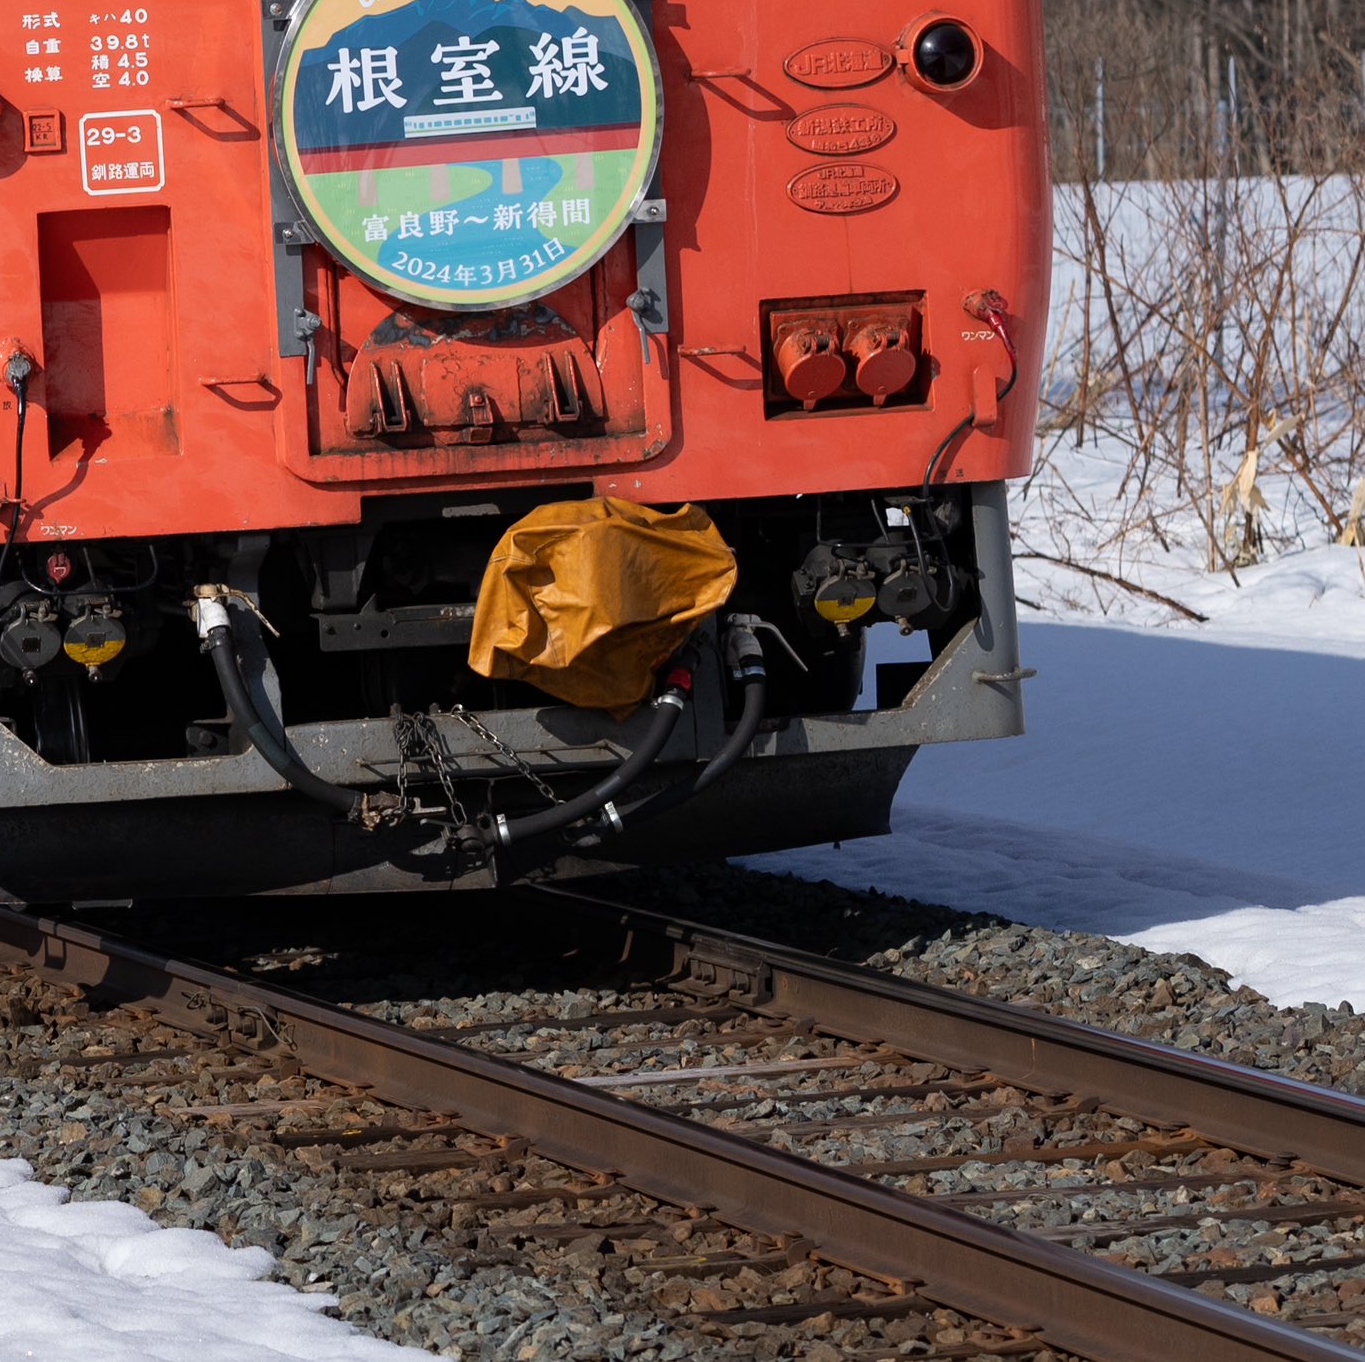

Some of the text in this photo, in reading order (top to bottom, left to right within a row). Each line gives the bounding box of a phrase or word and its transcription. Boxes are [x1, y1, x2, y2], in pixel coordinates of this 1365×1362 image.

[22, 8, 148, 30] 形式 キハ40
[25, 38, 61, 55] 自重
[118, 52, 149, 69] 4.5
[325, 26, 609, 113] 根室線
[24, 65, 63, 83] 換算
[92, 70, 150, 89] 空 4.0
[86, 126, 142, 146] 29-3
[91, 161, 155, 181] 釧路運両
[391, 237, 566, 286] 2024年3月31日
[961, 330, 996, 341] ワンマン
